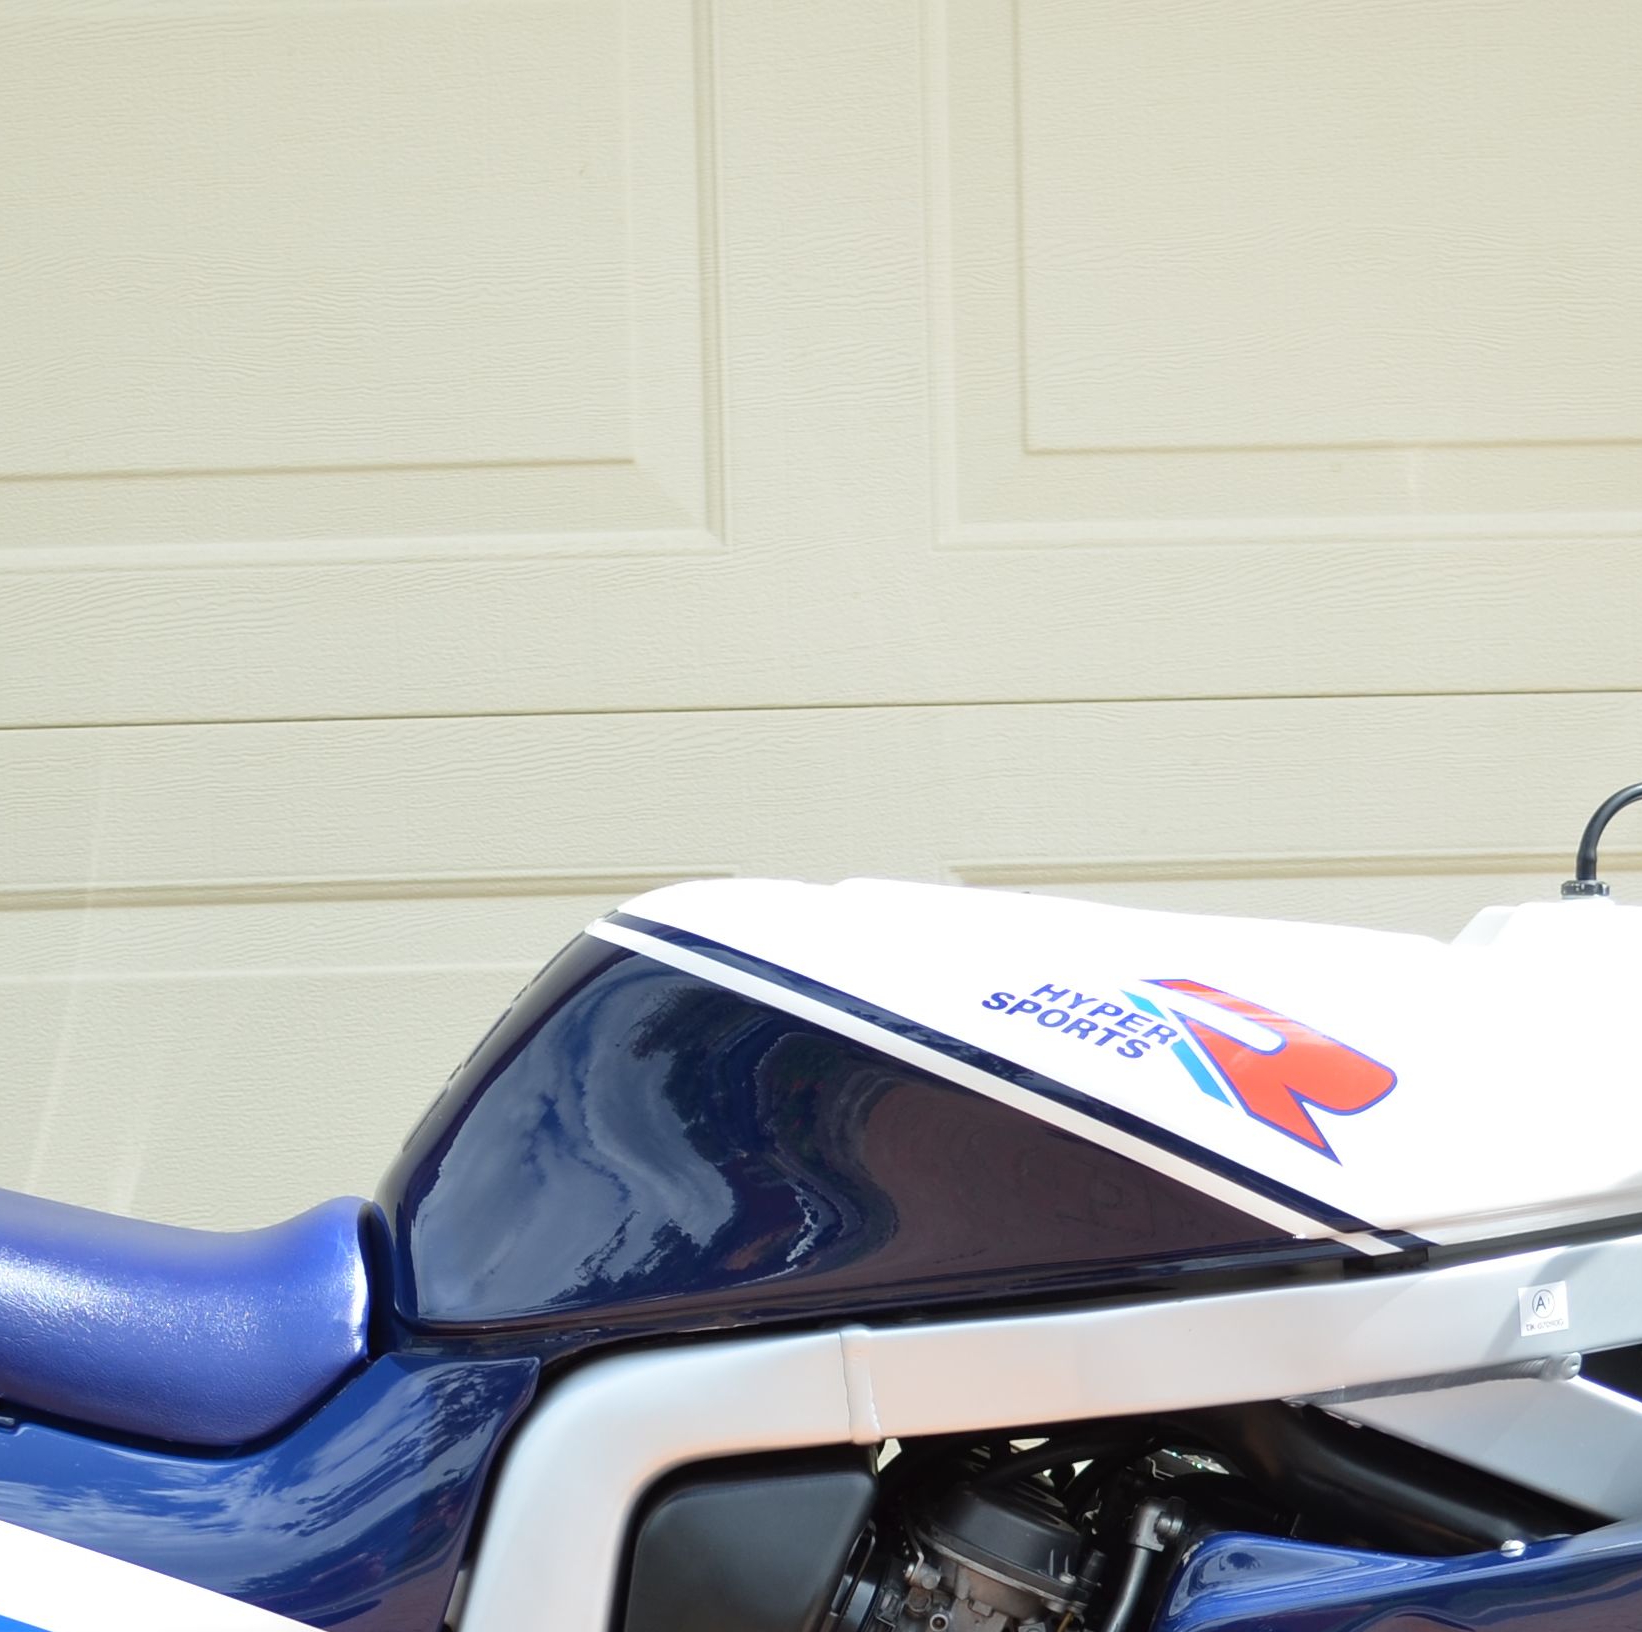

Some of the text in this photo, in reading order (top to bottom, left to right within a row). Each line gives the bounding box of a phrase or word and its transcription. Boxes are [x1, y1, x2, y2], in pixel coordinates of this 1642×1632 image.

[981, 992, 1152, 1059] SPORTS
[1030, 983, 1179, 1045] HYPER
[1139, 978, 1398, 1167] R
